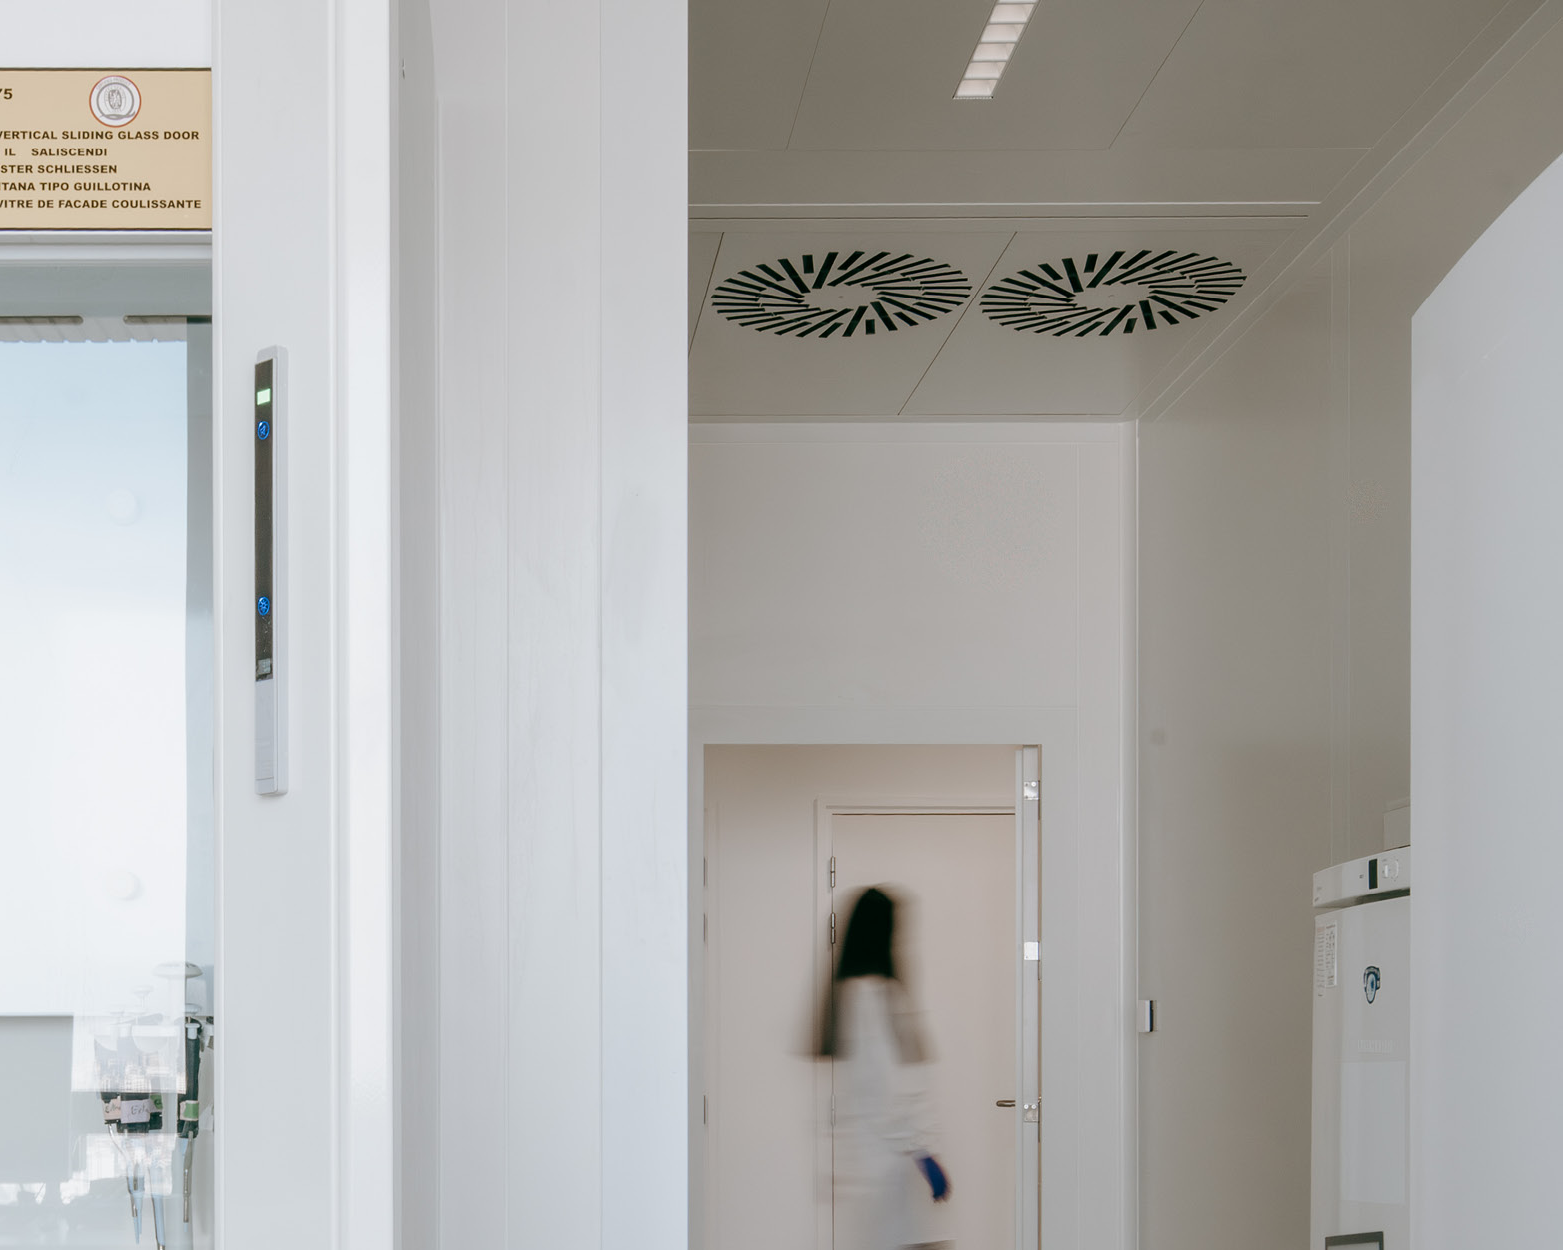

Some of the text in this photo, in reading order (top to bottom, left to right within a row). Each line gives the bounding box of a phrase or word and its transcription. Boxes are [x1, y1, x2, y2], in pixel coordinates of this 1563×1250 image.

[61, 130, 114, 140] SLIDING
[117, 130, 160, 140] GLASS
[163, 130, 200, 140] DOOR
[4, 148, 16, 156] IL
[31, 148, 108, 156] SALISCENDI
[37, 164, 118, 174] SCHLIESSEN
[39, 182, 70, 191] TIPO
[73, 182, 151, 191] GUILLOTINA
[37, 199, 54, 209] DE
[58, 199, 108, 209] FACADE
[111, 199, 202, 209] COULISSANTE
